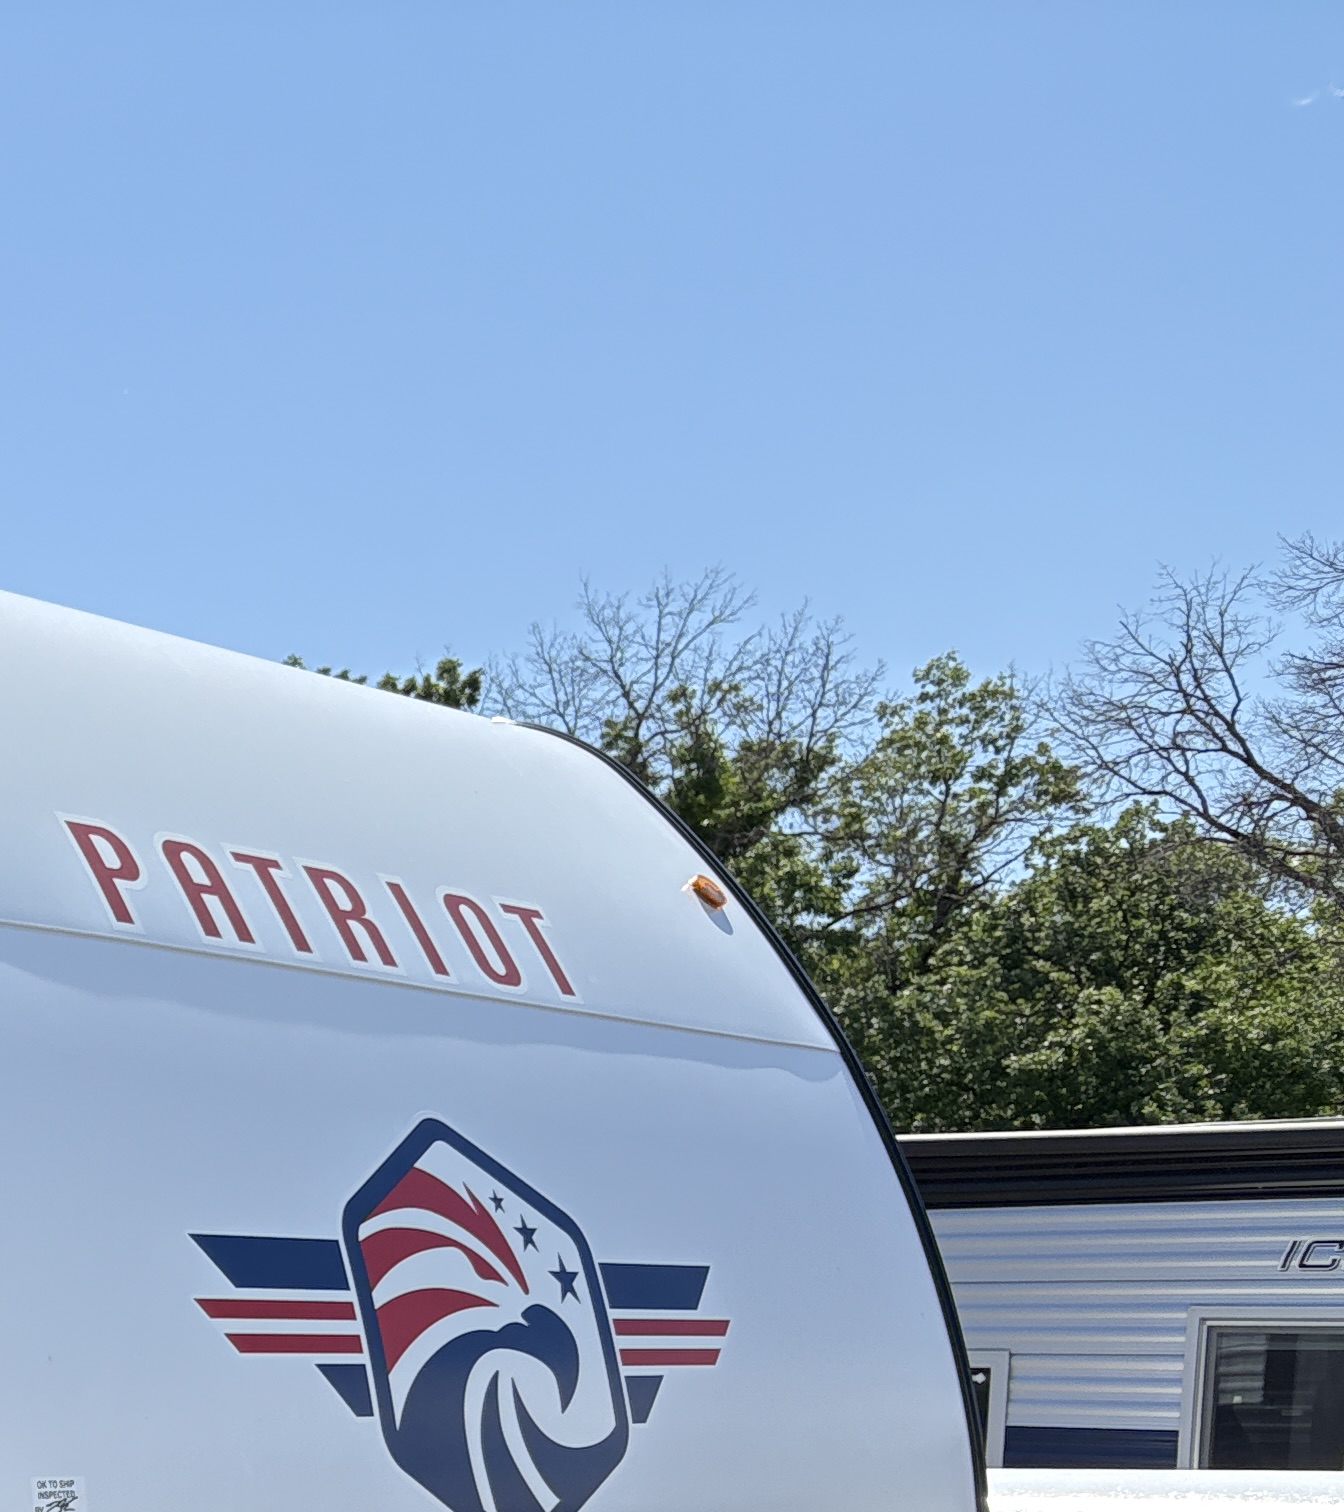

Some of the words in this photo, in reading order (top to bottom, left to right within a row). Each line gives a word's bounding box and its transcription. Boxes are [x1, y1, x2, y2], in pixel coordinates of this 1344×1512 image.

[62, 817, 578, 998] PATRIOT
[48, 1480, 58, 1489] TO
[37, 1489, 76, 1500] INSPECTED
